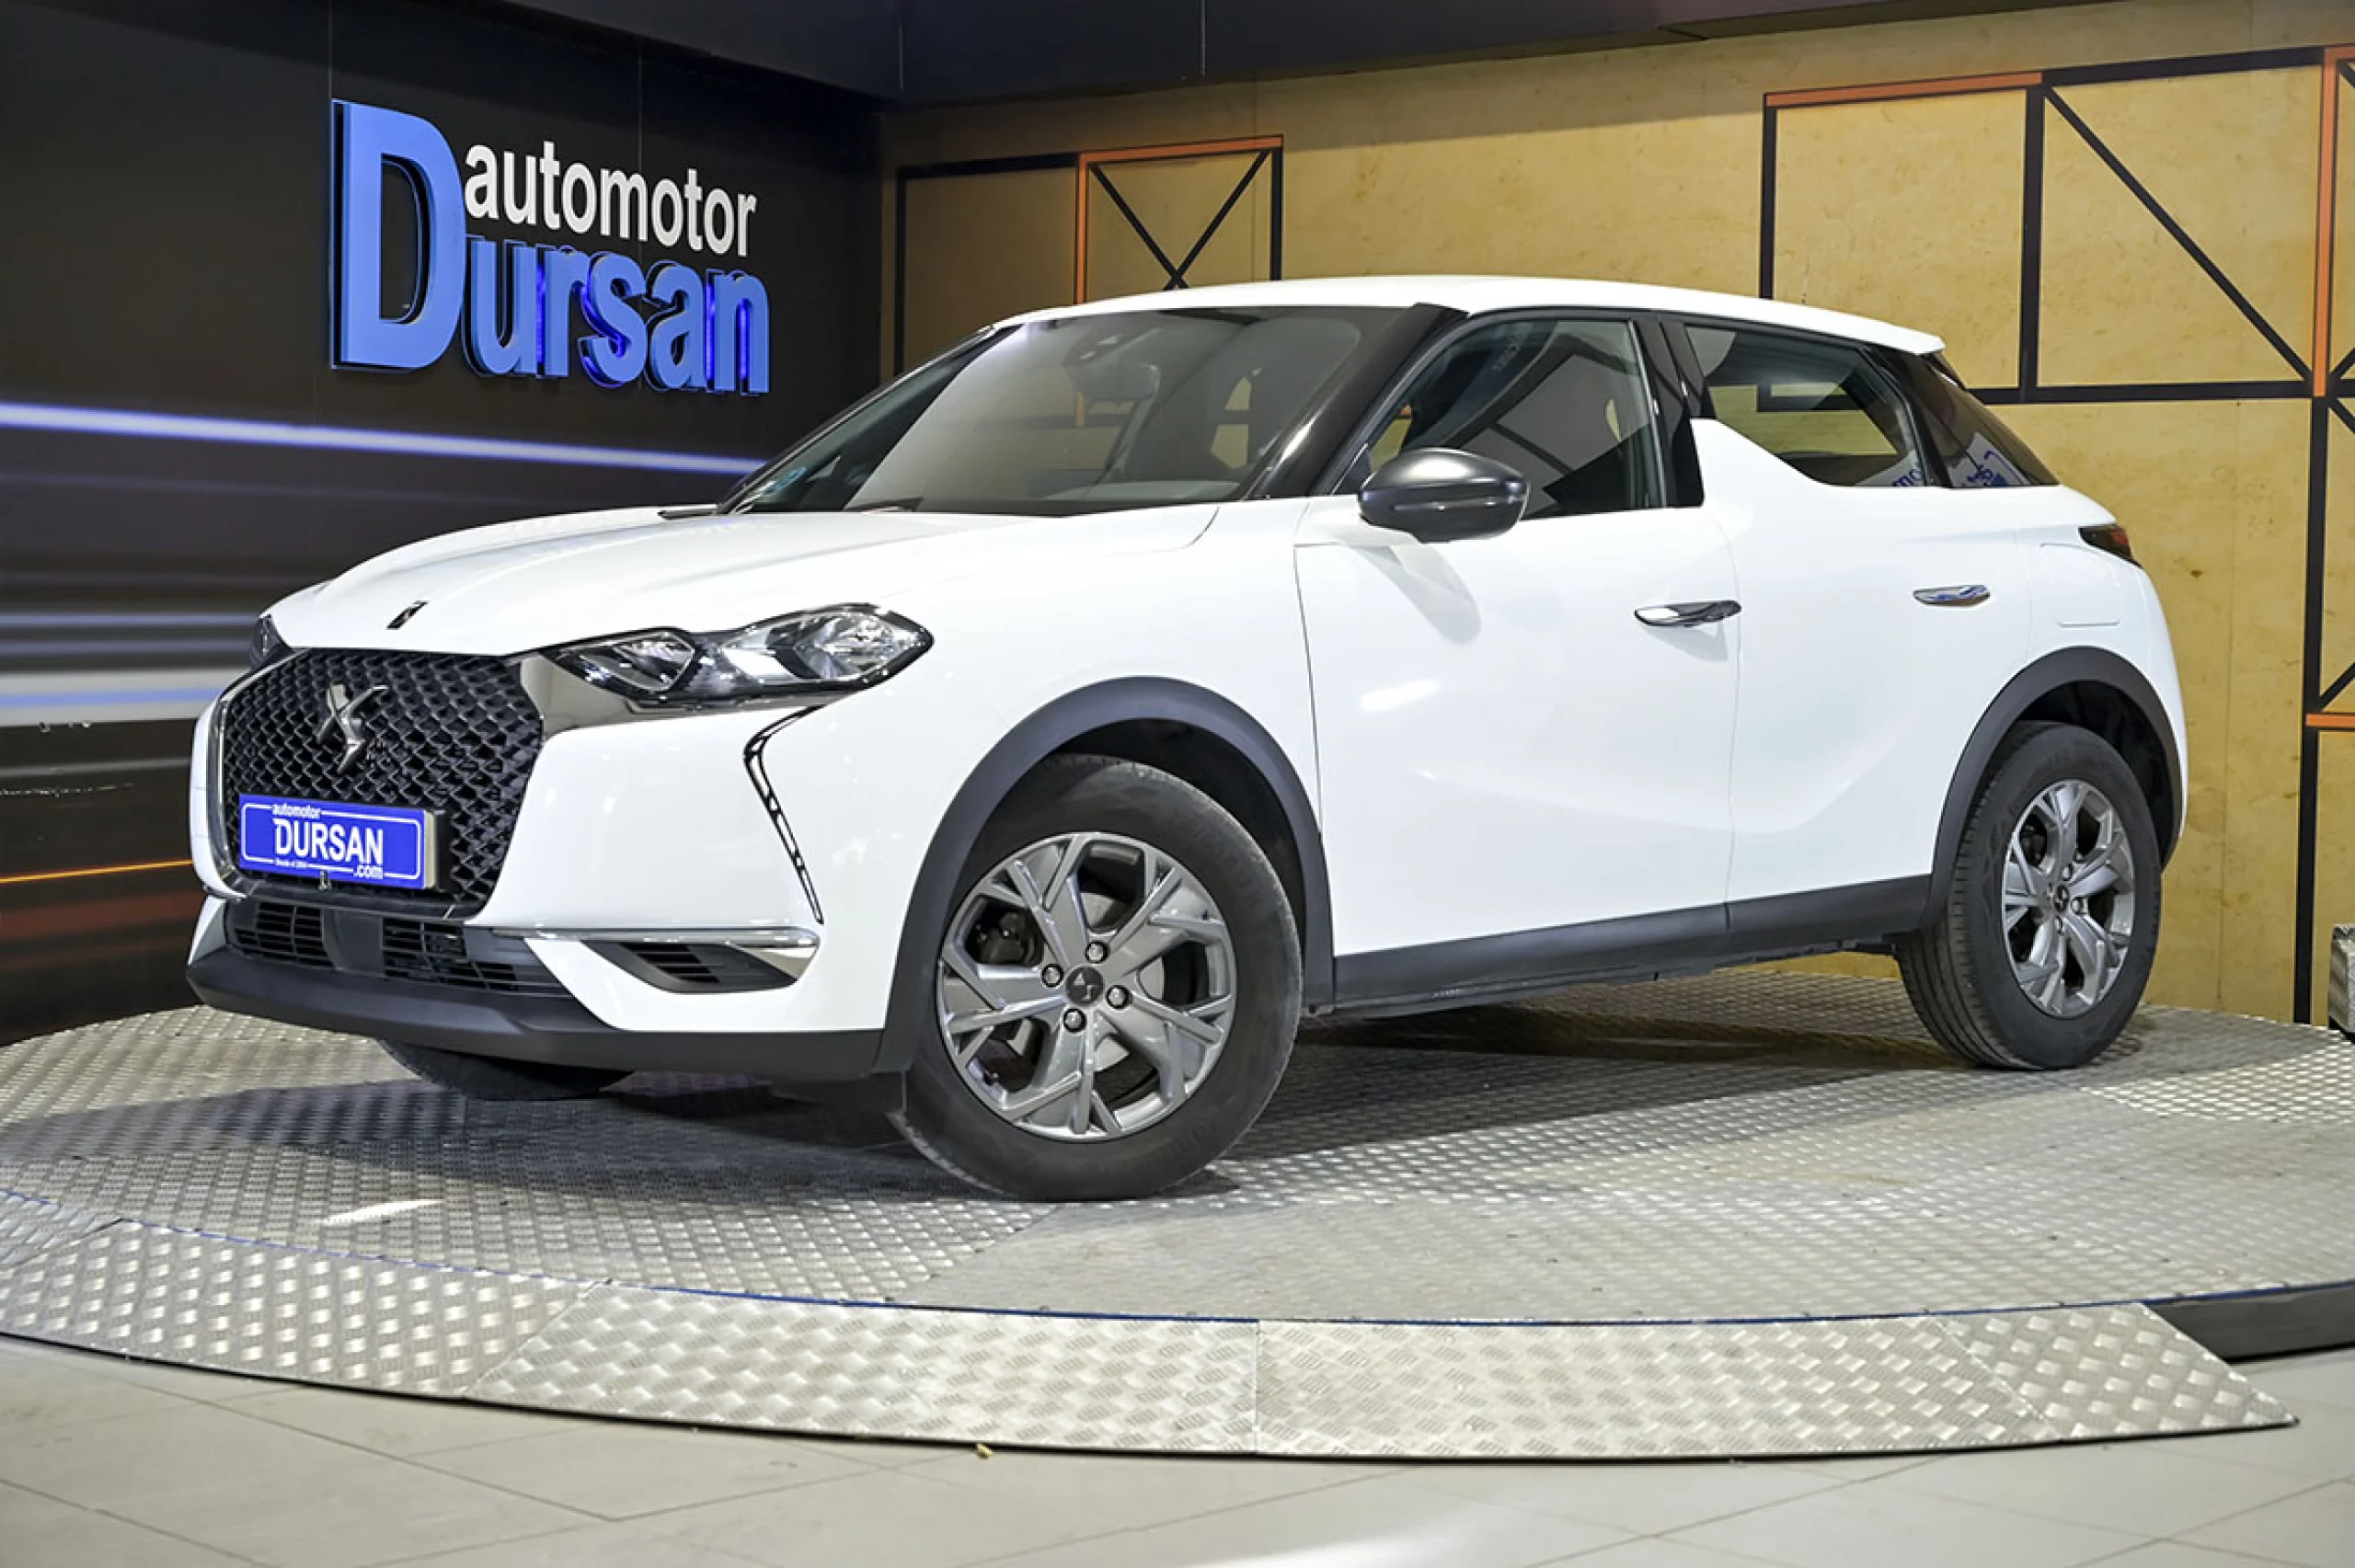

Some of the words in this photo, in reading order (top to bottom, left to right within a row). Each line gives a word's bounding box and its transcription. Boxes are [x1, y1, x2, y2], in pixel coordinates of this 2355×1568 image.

[464, 140, 758, 258] automotor
[331, 97, 771, 396] Dursan
[271, 802, 322, 819] automotor
[272, 818, 384, 864] DURSAN
[353, 864, 384, 880] .com
